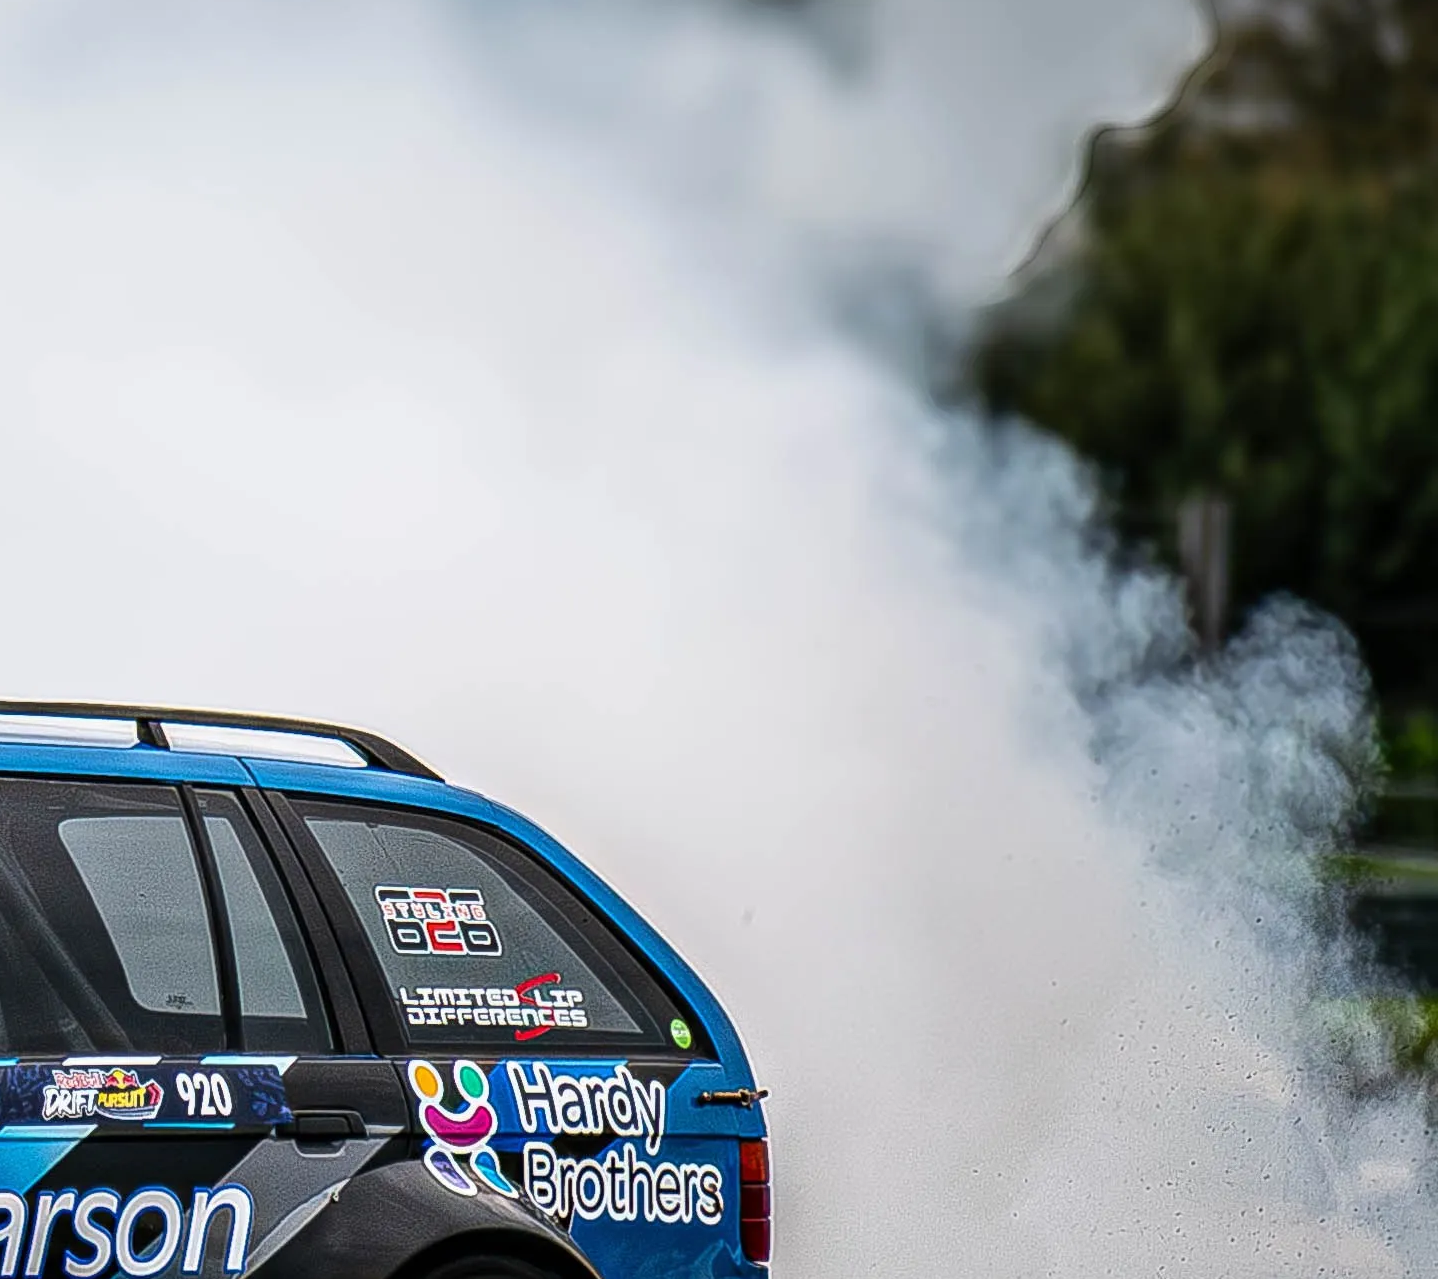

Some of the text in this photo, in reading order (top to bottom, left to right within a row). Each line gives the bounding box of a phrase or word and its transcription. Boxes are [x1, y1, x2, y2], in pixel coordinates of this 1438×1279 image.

[382, 902, 486, 920] STYLING
[400, 987, 520, 1006] LIMITED
[406, 1008, 588, 1028] DIFFERENCES
[45, 1086, 147, 1116] DRIFT PURSUIT
[175, 1072, 233, 1116] 920
[506, 1061, 665, 1153] Hardy
[524, 1142, 723, 1224] Brothers
